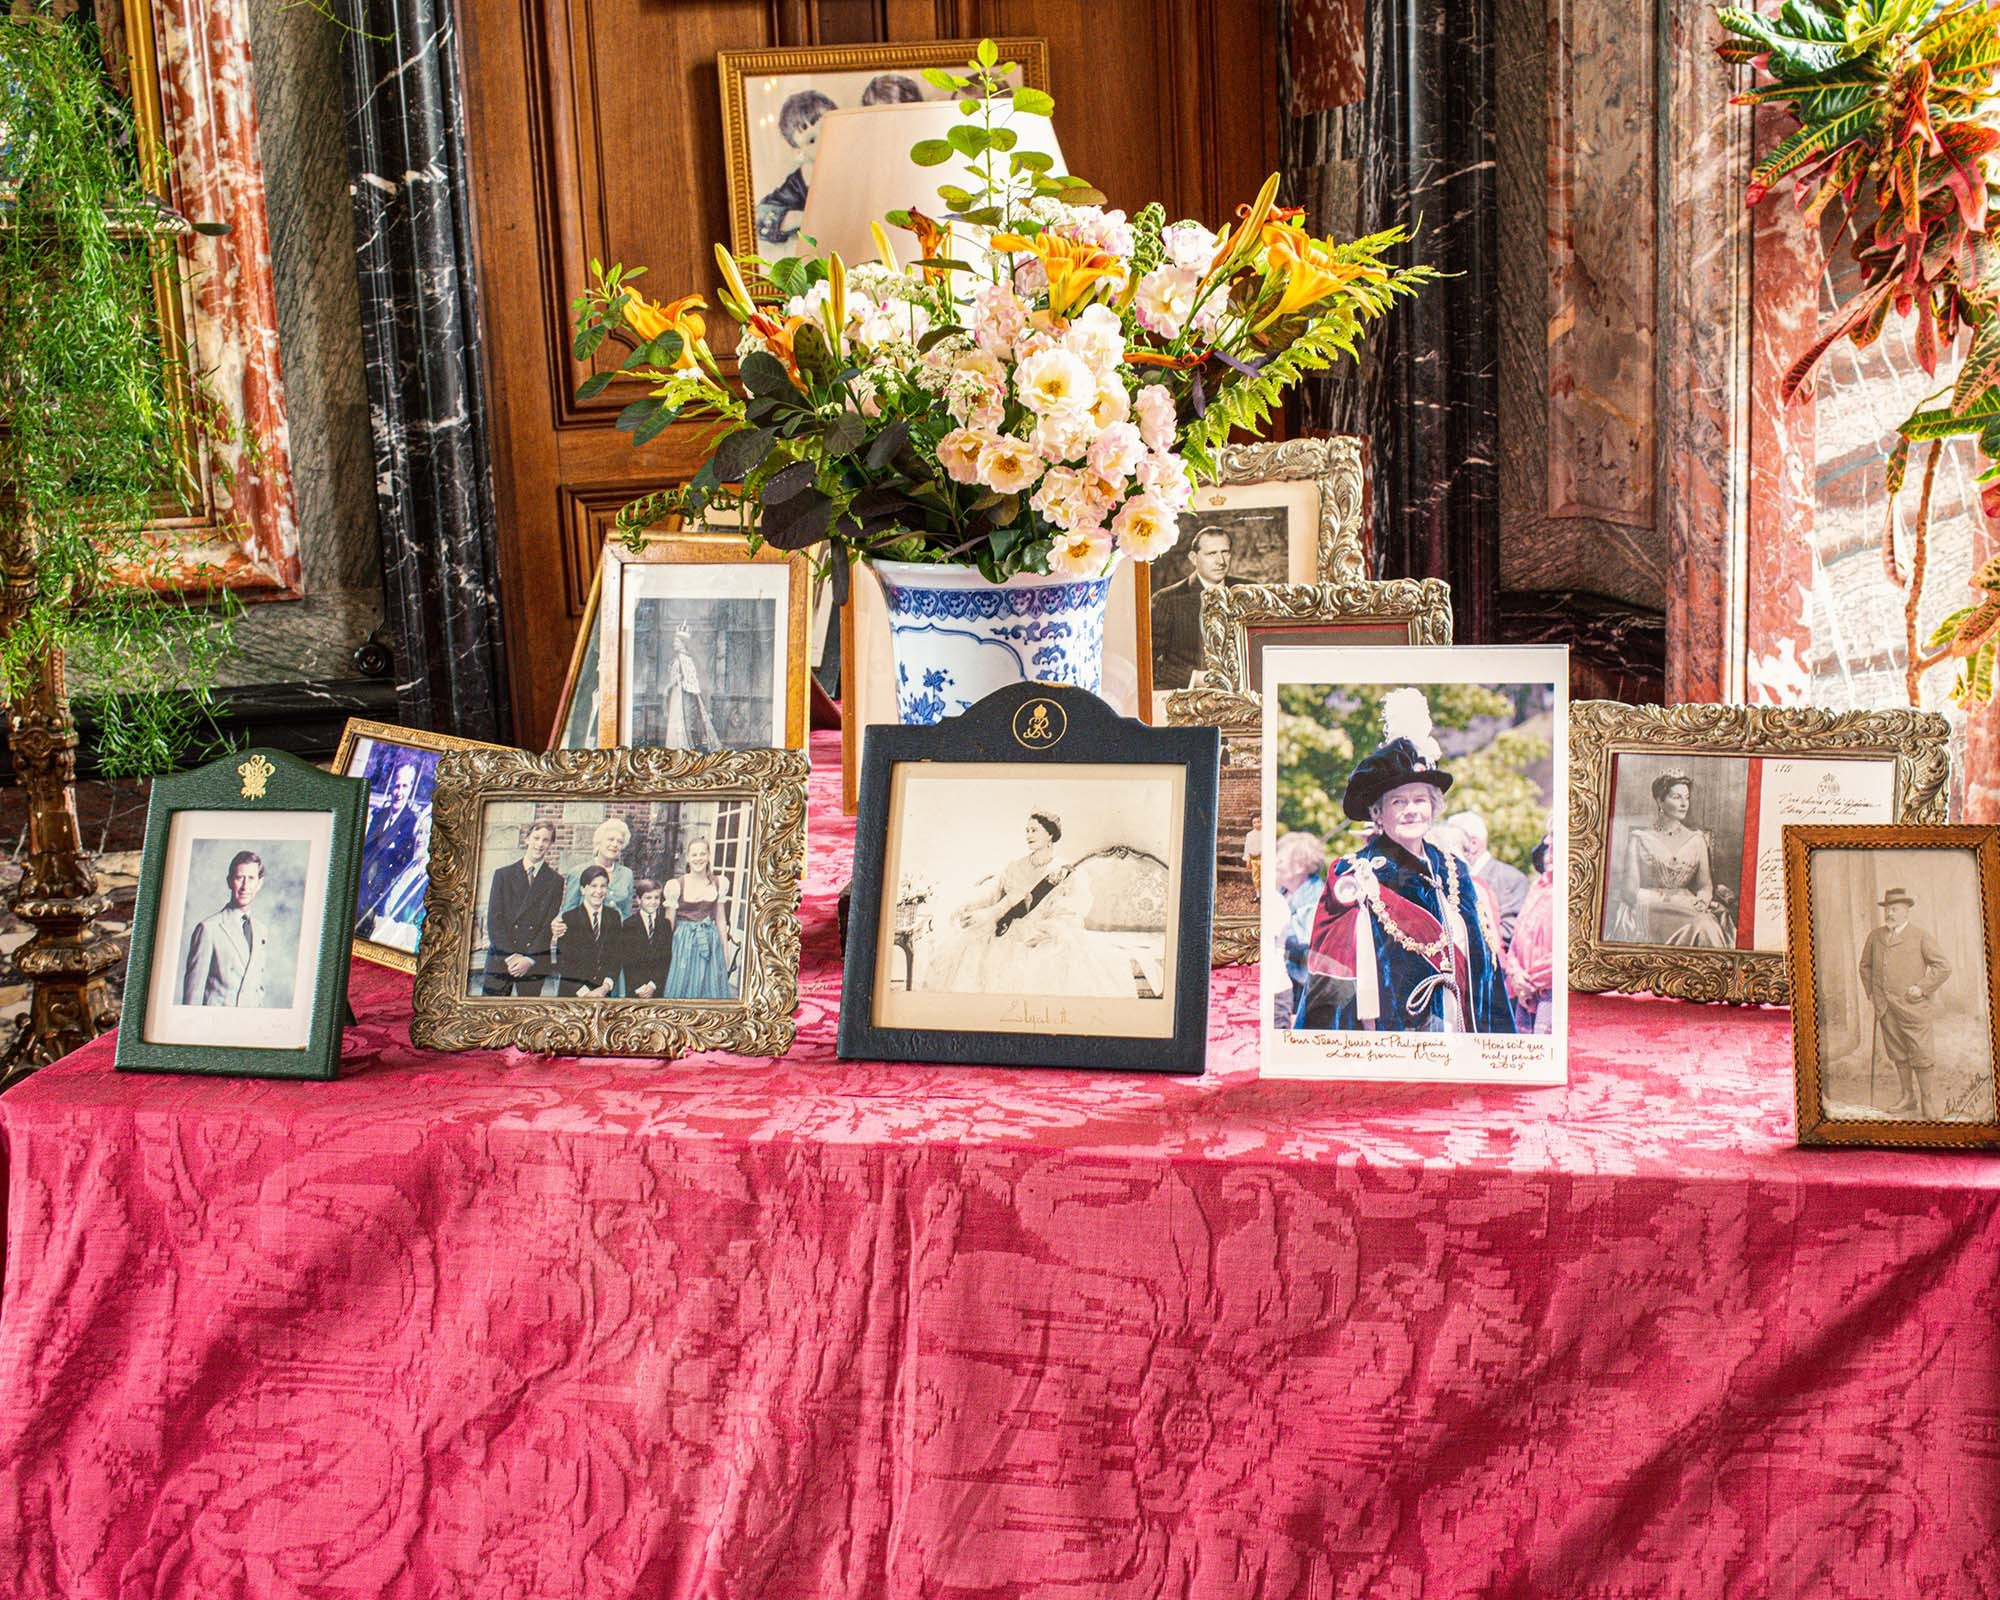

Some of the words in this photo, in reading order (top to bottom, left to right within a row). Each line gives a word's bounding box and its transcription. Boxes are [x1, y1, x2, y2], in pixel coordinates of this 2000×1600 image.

[1282, 1030, 1310, 1045] Pour
[1326, 1049, 1364, 1059] Love
[1367, 1049, 1407, 1061] from
[1413, 1049, 1452, 1066] Mary
